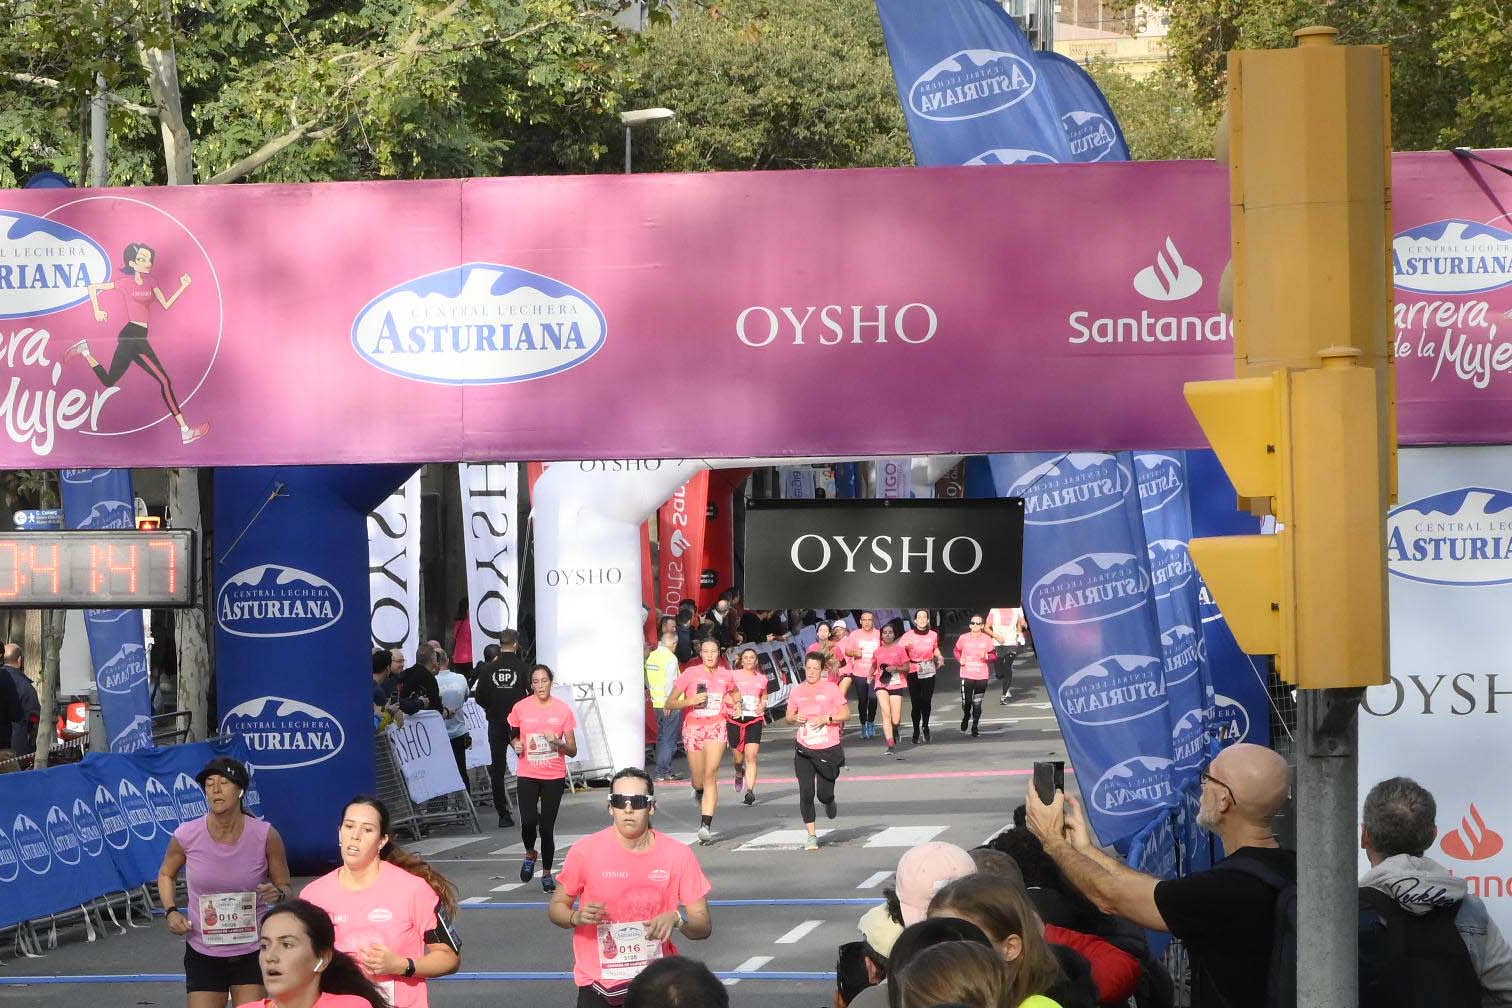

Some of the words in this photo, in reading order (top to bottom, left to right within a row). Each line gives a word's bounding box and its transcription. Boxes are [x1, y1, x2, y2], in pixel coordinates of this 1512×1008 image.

[14, 246, 86, 258] LECHERA
[1464, 244, 1512, 253] LECHER
[410, 304, 493, 319] CENTRAL
[498, 302, 578, 316] LECHERA
[1393, 301, 1490, 329] arrera
[371, 309, 587, 355] ASTURIANA
[736, 303, 938, 347] OYSHO
[1069, 311, 1234, 345] Santand
[1418, 330, 1436, 358] la
[1430, 324, 1512, 389] Muje
[1414, 522, 1482, 533] CENTRAL
[790, 534, 984, 576] OYSHO
[546, 567, 623, 587] OYSHO
[234, 590, 278, 598] CENTRAL
[282, 589, 330, 597] LECHERA
[221, 597, 334, 621] ASTURIANA
[498, 672, 512, 682] BP
[235, 722, 278, 730] CENTRAL
[282, 721, 330, 729] LECHERA
[619, 944, 641, 954] 016
